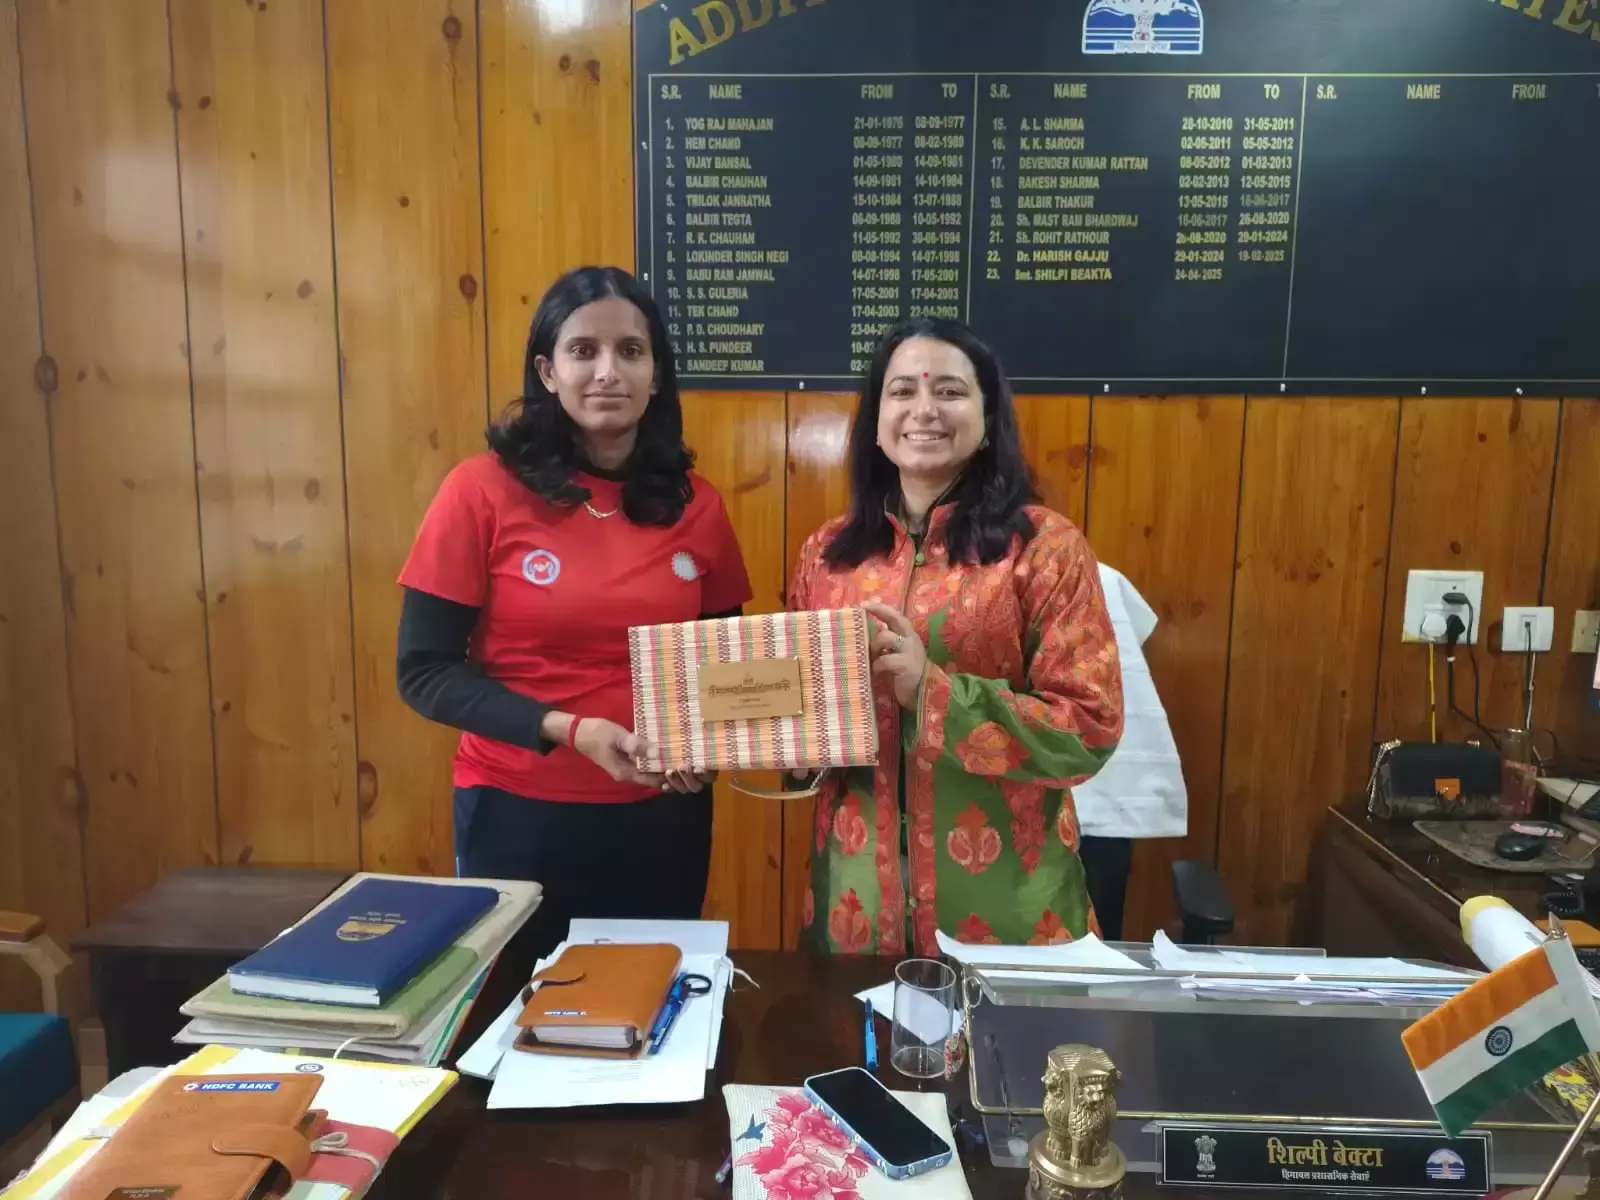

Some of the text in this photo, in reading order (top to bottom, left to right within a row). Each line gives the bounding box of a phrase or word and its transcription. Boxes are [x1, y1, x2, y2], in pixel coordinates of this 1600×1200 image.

[661, 83, 957, 100] S.R. NAME FROM TO
[990, 84, 1280, 99] S.R. NAME FROM TO
[1316, 84, 1547, 99] S.R. NAME FROM
[665, 118, 674, 131] 1.
[685, 118, 705, 130] YOG
[708, 118, 725, 130] RAJ
[727, 118, 773, 131] MAHAJAN
[993, 118, 1006, 131] 15.
[1020, 118, 1030, 131] A.
[1033, 118, 1041, 131] L.
[1044, 118, 1084, 131] SHARMA
[1244, 117, 1294, 130] 31-05-2011
[665, 138, 674, 149] 2.
[685, 137, 706, 150] HEM
[708, 137, 741, 150] CHAND
[1020, 137, 1031, 150] K.
[1033, 137, 1042, 150] K.
[1045, 137, 1084, 150] SAROCH
[665, 157, 674, 169] 3.
[685, 156, 712, 169] VIJAY
[715, 156, 752, 169] BANSAL
[991, 157, 1005, 170] 17.
[1019, 157, 1070, 170] DEVENDER
[1072, 157, 1107, 170] KUMAR
[1110, 156, 1149, 170] RATTAN
[1242, 156, 1292, 169] 01-02-2013
[666, 176, 675, 188] 4.
[686, 176, 720, 188] BALBIR
[722, 176, 767, 188] CHAUHAN
[1019, 176, 1057, 189] RAKESH
[1059, 176, 1099, 189] SHARMA
[666, 195, 675, 207] 5.
[686, 195, 720, 207] TRILOK
[1018, 196, 1052, 209] BALBIR
[1054, 196, 1094, 209] THAKUR
[666, 213, 676, 225] 6.
[722, 213, 752, 226] TEGTA
[990, 214, 1004, 227] 20.
[1016, 215, 1031, 227] Sh.
[1033, 214, 1060, 227] MAST
[1062, 214, 1082, 227] RAM
[1085, 214, 1138, 227] BHARDWAJ
[666, 232, 676, 244] 7.
[686, 232, 695, 244] R.
[698, 232, 707, 244] K.
[710, 232, 755, 244] CHAUHAN
[989, 231, 1003, 243] 21.
[1016, 232, 1030, 244] Sh.
[1033, 232, 1062, 244] ROHIT
[1064, 232, 1109, 244] RATHOUR
[687, 251, 733, 263] LOKINDER
[735, 251, 764, 263] SINGH
[767, 251, 789, 263] NEGI
[987, 250, 1001, 262] 22.
[1017, 251, 1030, 262] Dr.
[1033, 250, 1072, 262] HARISH
[1075, 250, 1109, 262] GAJJU
[687, 269, 712, 281] BABU
[714, 269, 734, 281] RAM
[736, 269, 775, 281] JAMWAL
[986, 268, 1000, 279] 23.
[1035, 269, 1068, 281] SHILPI
[1071, 268, 1112, 280] BEAKTA
[668, 288, 680, 299] 10.
[708, 288, 748, 299] GULERIA
[668, 306, 681, 317] 11.
[687, 305, 705, 317] TEK
[707, 305, 739, 317] CHAND
[708, 324, 764, 336] CHOUDHARY
[687, 342, 696, 353] H.
[710, 341, 752, 353] PUNDEER
[687, 360, 729, 371] SANDEEP
[731, 360, 764, 371] KUMAR
[1266, 1137, 1328, 1165] शिल्पी
